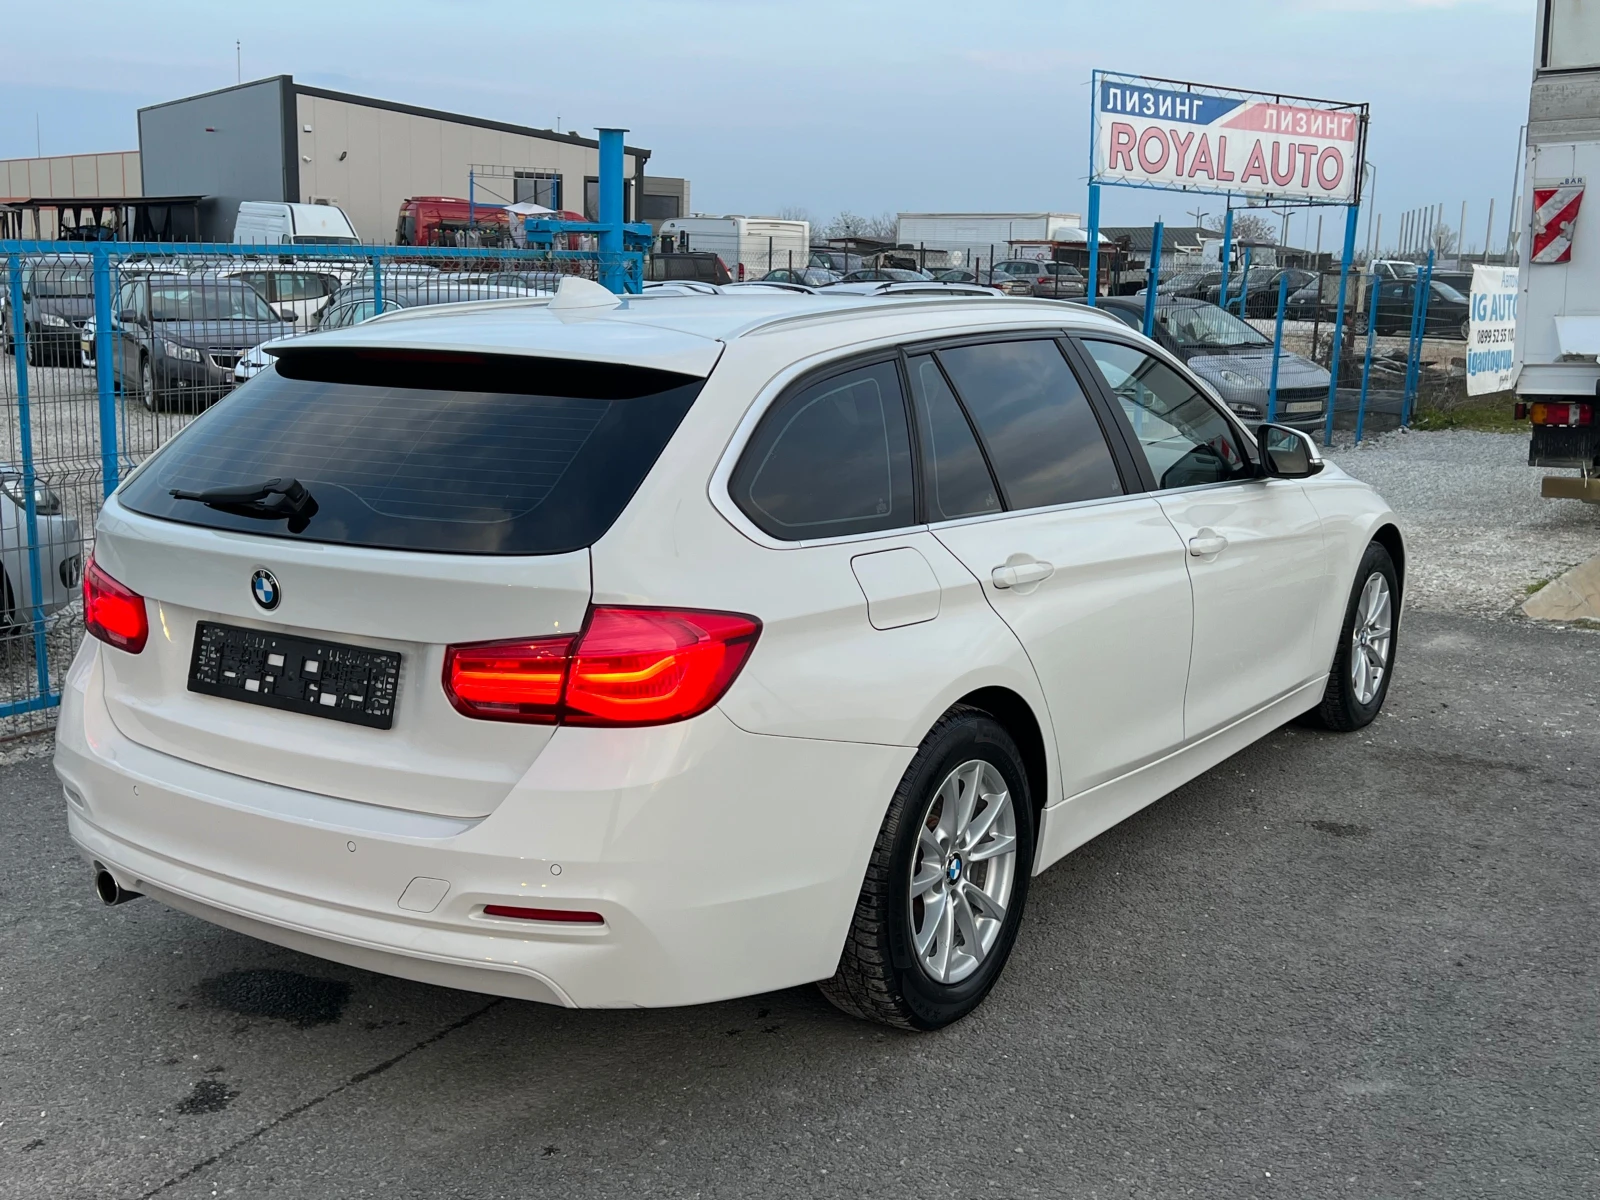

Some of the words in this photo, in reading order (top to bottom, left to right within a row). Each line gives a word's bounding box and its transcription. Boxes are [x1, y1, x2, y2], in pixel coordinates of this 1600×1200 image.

[1107, 87, 1203, 121] ЛИЗИНГ
[1263, 109, 1352, 138] ЛИЗИНГ
[1109, 122, 1235, 182] ROYAL
[1240, 138, 1344, 191] AUTO
[1472, 293, 1488, 321] IG
[1477, 329, 1492, 344] 0899
[1493, 328, 1500, 343] 52
[1500, 328, 1507, 343] 55
